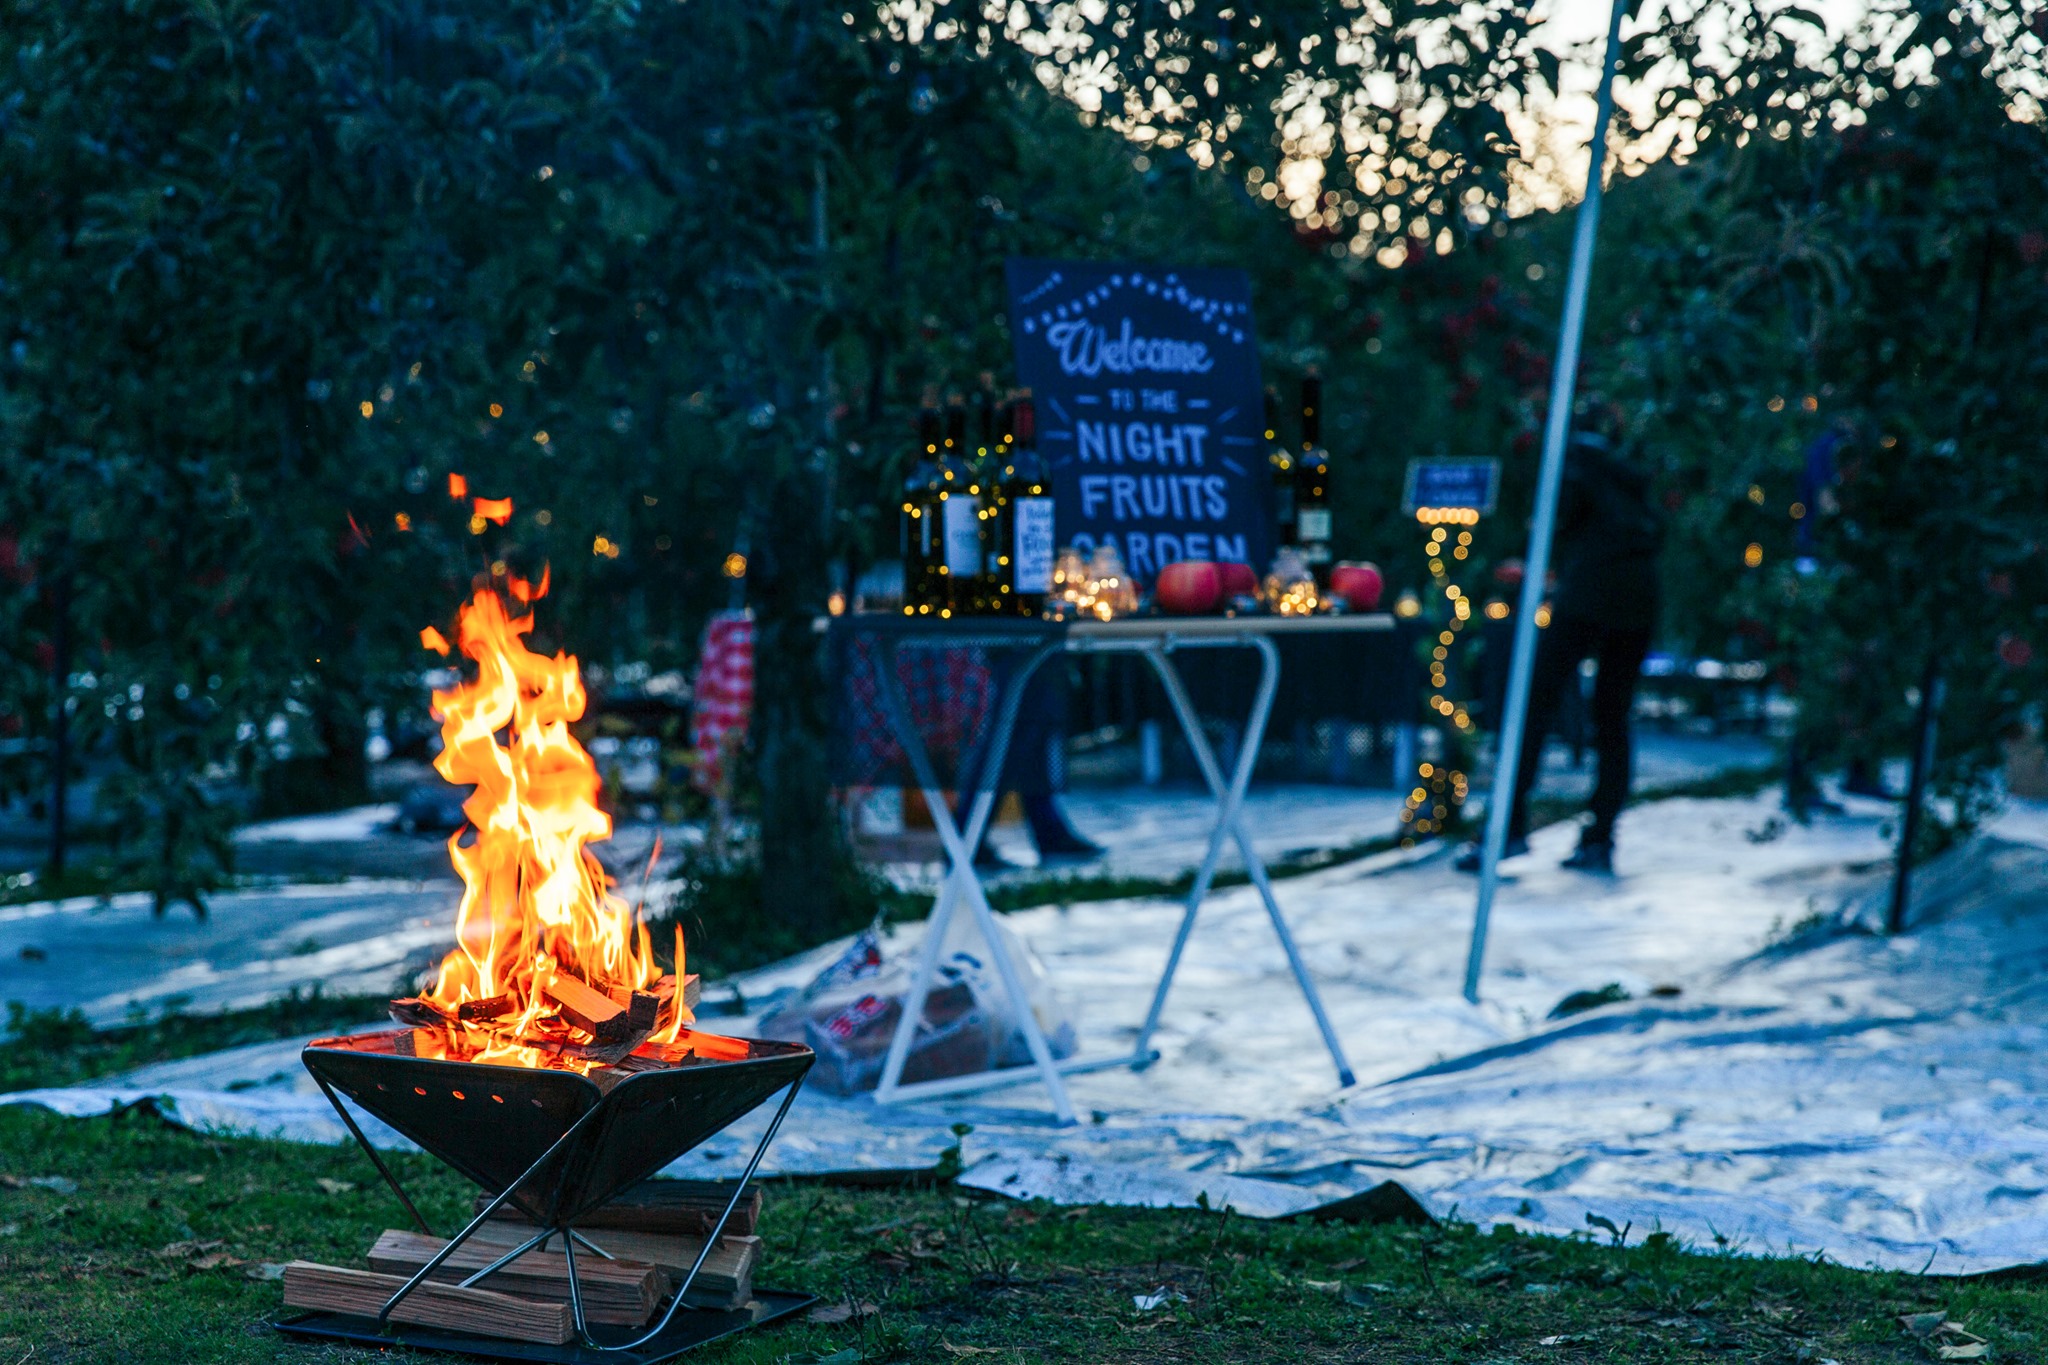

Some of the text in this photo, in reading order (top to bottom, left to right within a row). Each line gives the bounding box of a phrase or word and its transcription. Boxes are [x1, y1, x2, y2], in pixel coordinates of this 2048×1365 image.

[1047, 318, 1213, 376] Welcome
[1108, 389, 1179, 412] TO THE
[1077, 422, 1208, 465] NIGHT
[1080, 475, 1228, 520] FRUITS
